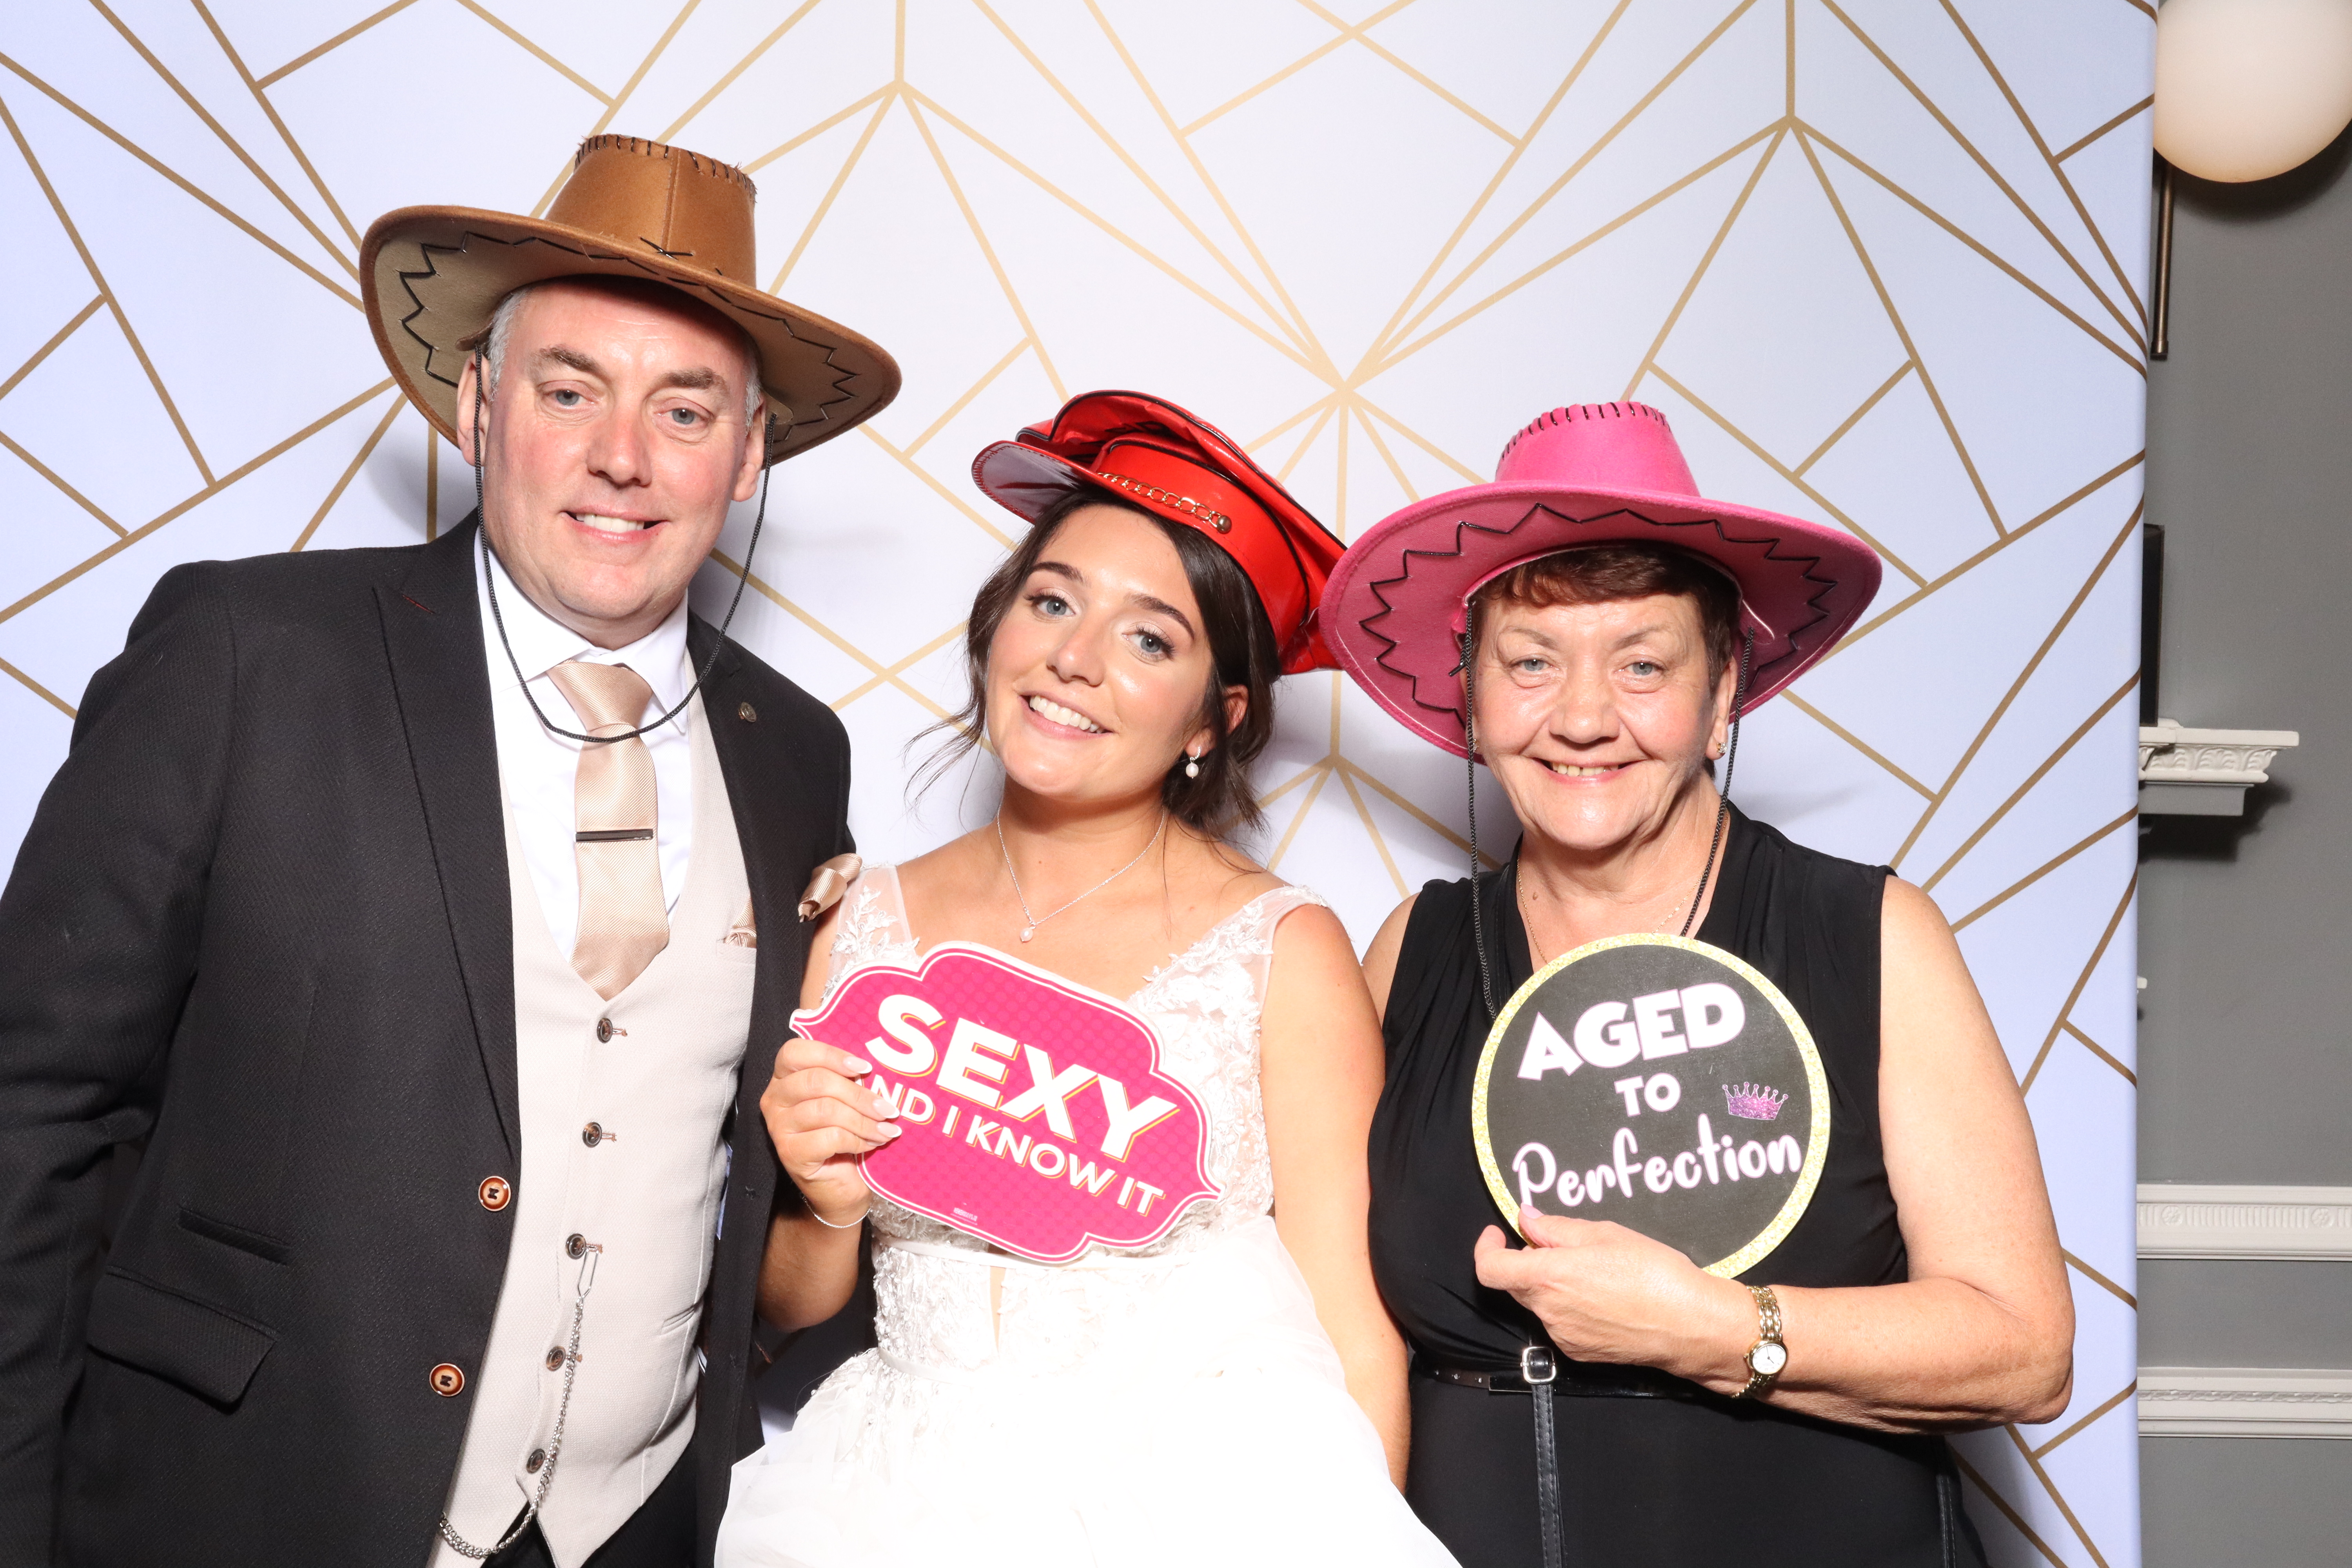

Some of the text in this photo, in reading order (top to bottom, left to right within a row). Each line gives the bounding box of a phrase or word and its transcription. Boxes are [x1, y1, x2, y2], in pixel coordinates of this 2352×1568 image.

[865, 994, 1180, 1162] SEXY
[1517, 982, 1746, 1081] AGED
[1614, 1073, 1681, 1117] TO
[855, 1073, 1166, 1217] ND I KNOW IT
[1512, 1113, 1801, 1207] Perfection
